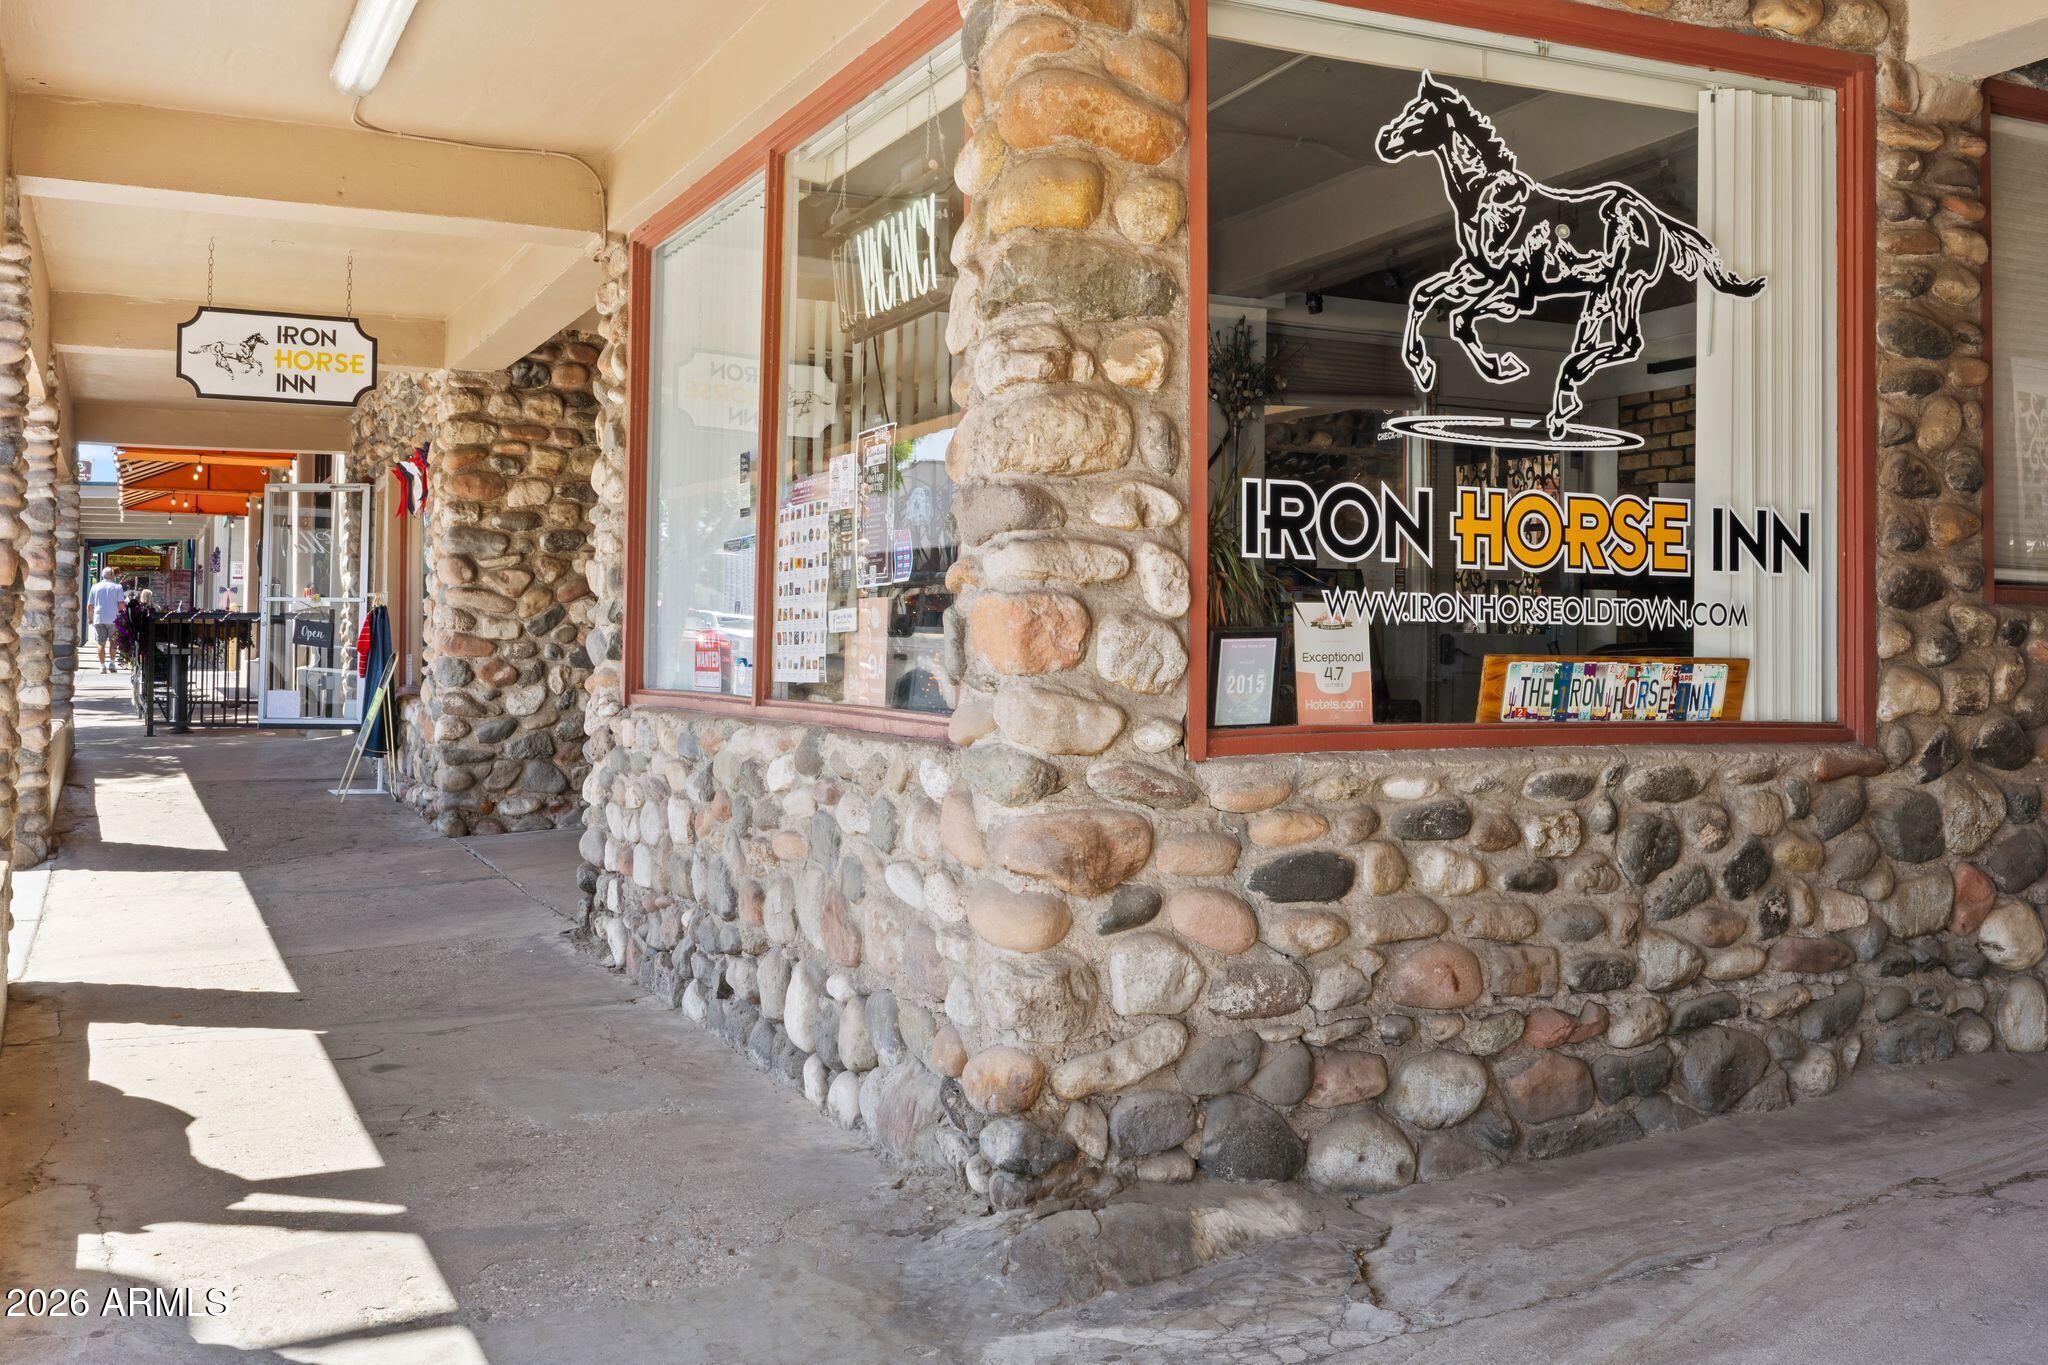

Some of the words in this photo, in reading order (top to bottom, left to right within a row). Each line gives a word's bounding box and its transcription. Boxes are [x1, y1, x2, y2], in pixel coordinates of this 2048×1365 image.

[856, 192, 938, 319] VACANCY
[276, 325, 337, 348] IRON
[274, 348, 365, 375] HORSE
[276, 373, 316, 394] INN
[1240, 477, 1434, 569] IRON
[1449, 485, 1691, 577] HORSE
[1711, 505, 1812, 577] INN
[1321, 585, 1749, 631] WWW.IRONHORSEOLDTOWN.COM
[301, 625, 325, 641] Open
[1302, 651, 1364, 664] Exceptional
[1226, 673, 1265, 695] 2015
[1324, 666, 1344, 681] 4.7
[1305, 699, 1364, 710] Hotels.com
[1520, 677, 1554, 707] THE
[1612, 679, 1671, 714] HORSE
